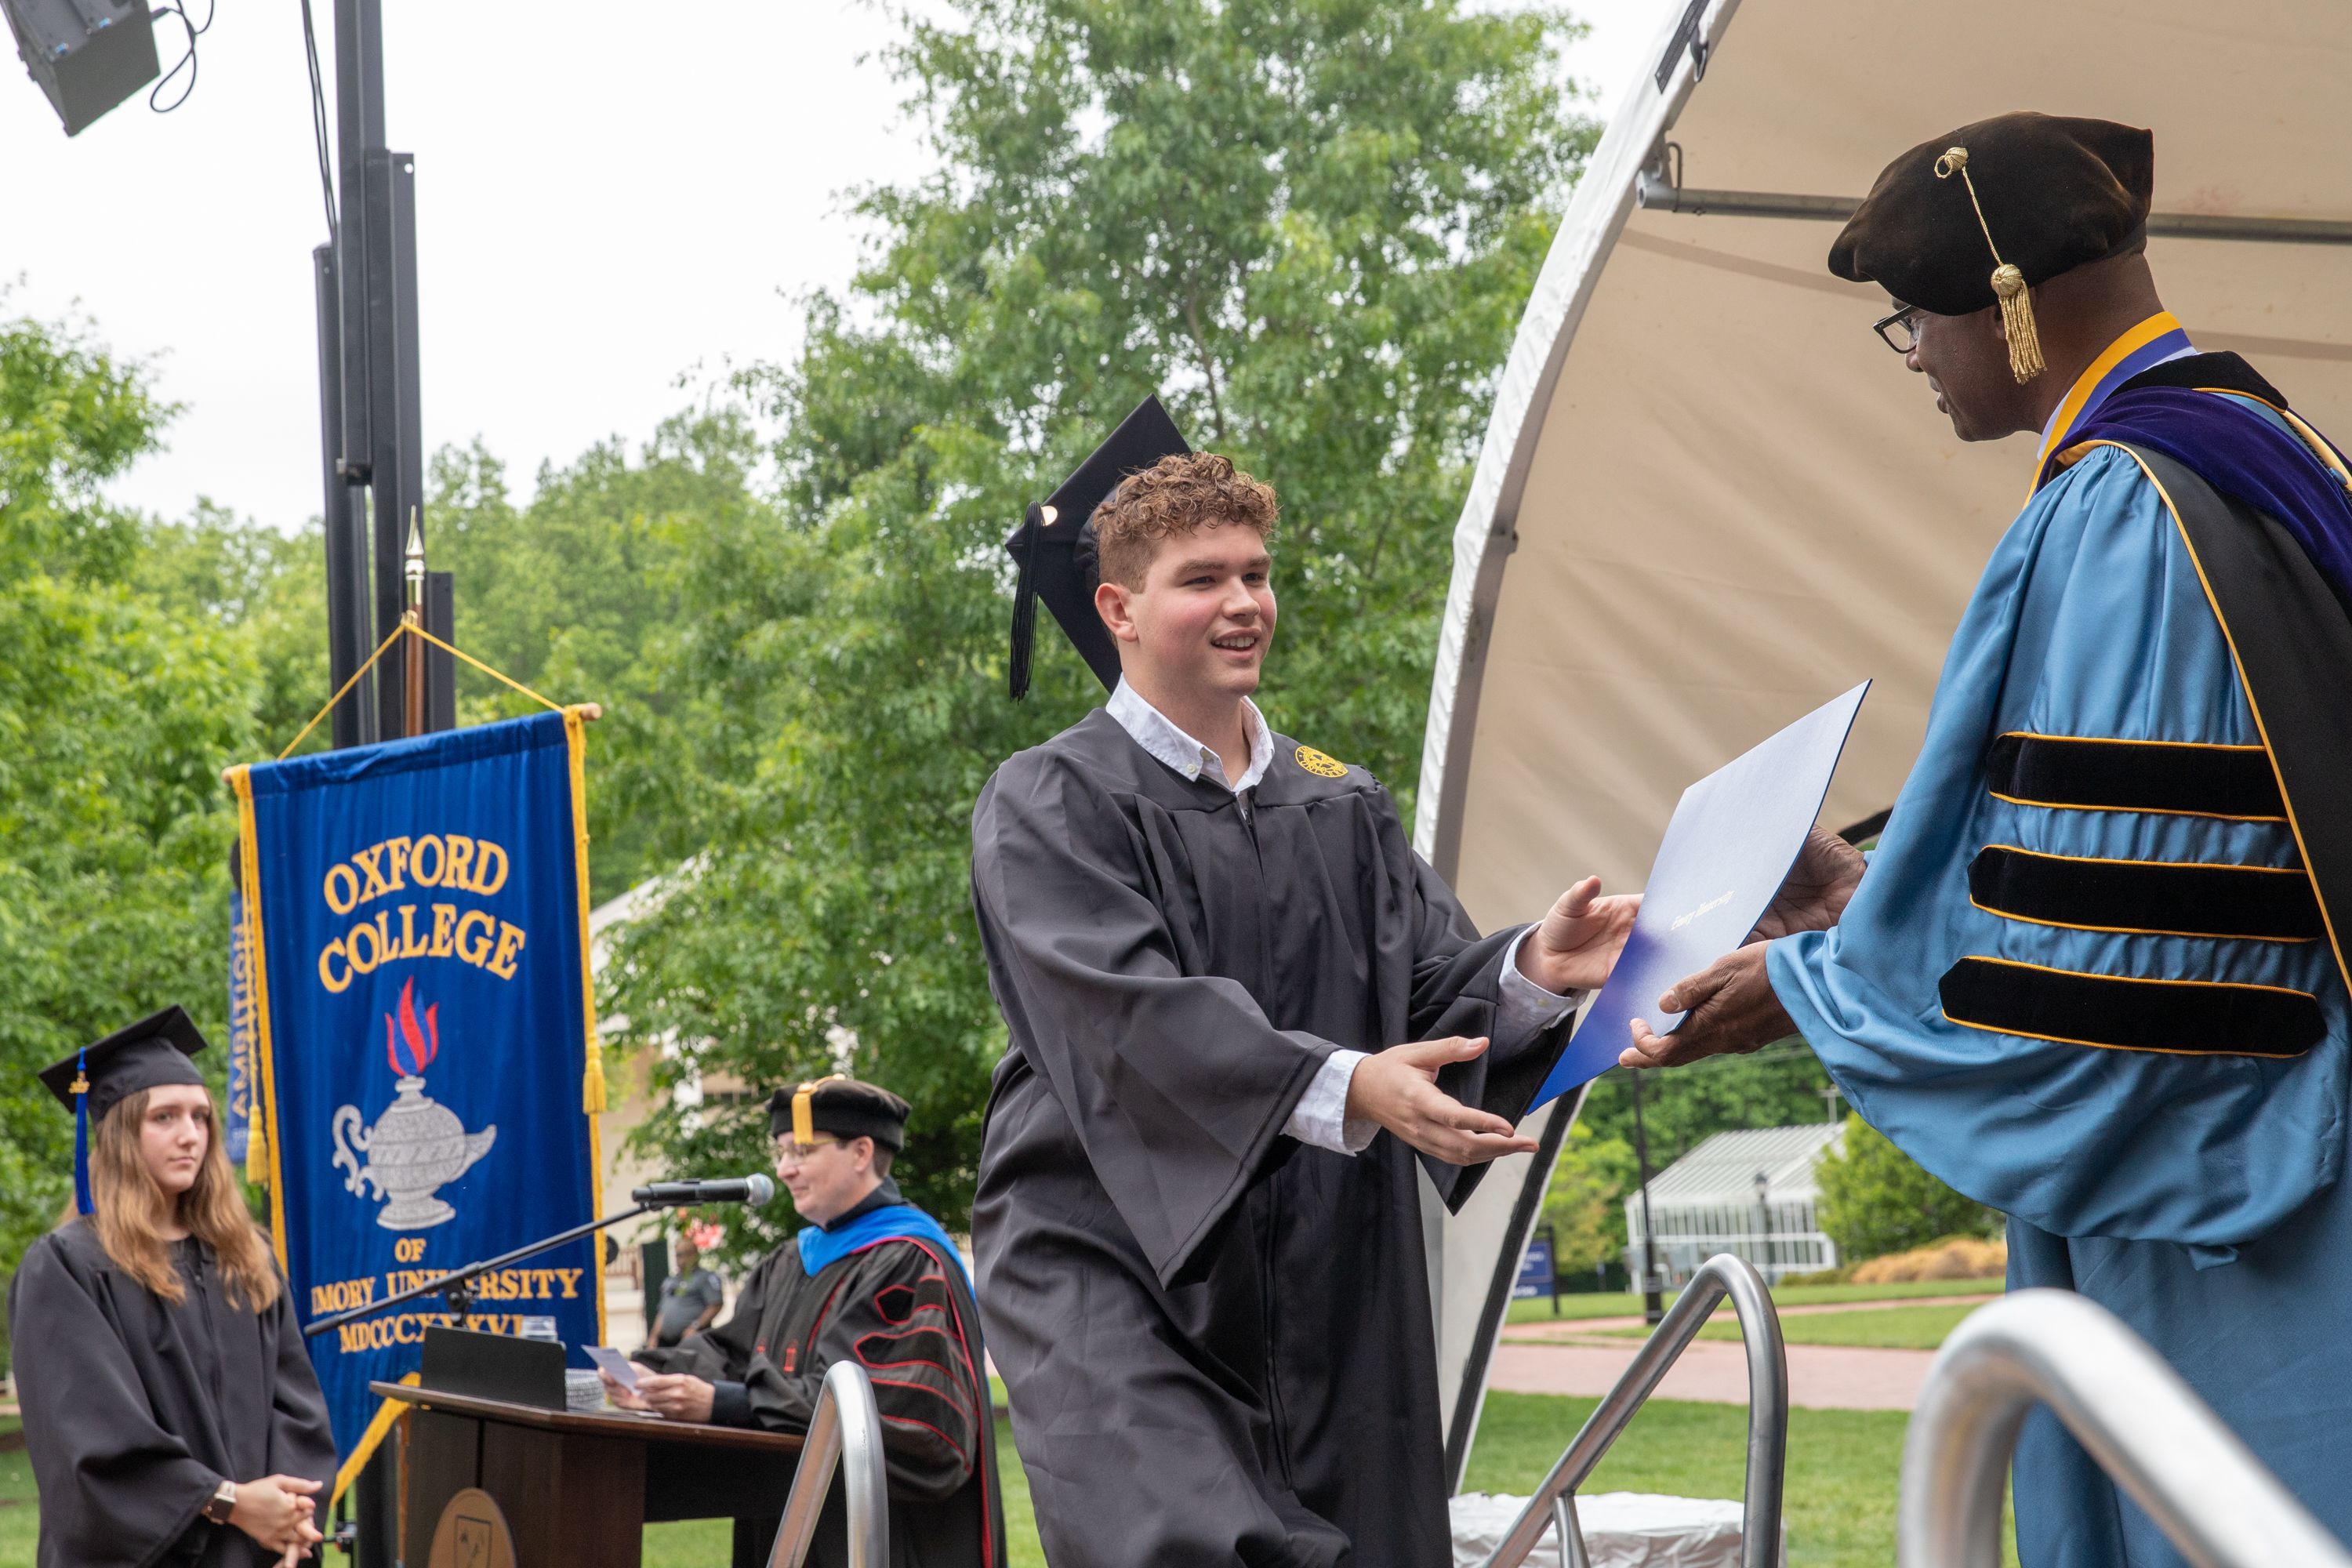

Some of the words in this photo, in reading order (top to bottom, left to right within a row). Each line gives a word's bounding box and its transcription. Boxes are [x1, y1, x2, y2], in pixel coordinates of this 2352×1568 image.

[324, 834, 509, 915] OXFORD
[318, 903, 526, 993] COLLEGE
[394, 1237, 426, 1262] OF
[310, 1276, 376, 1316] MORY
[386, 1268, 583, 1300] UNIRSITY
